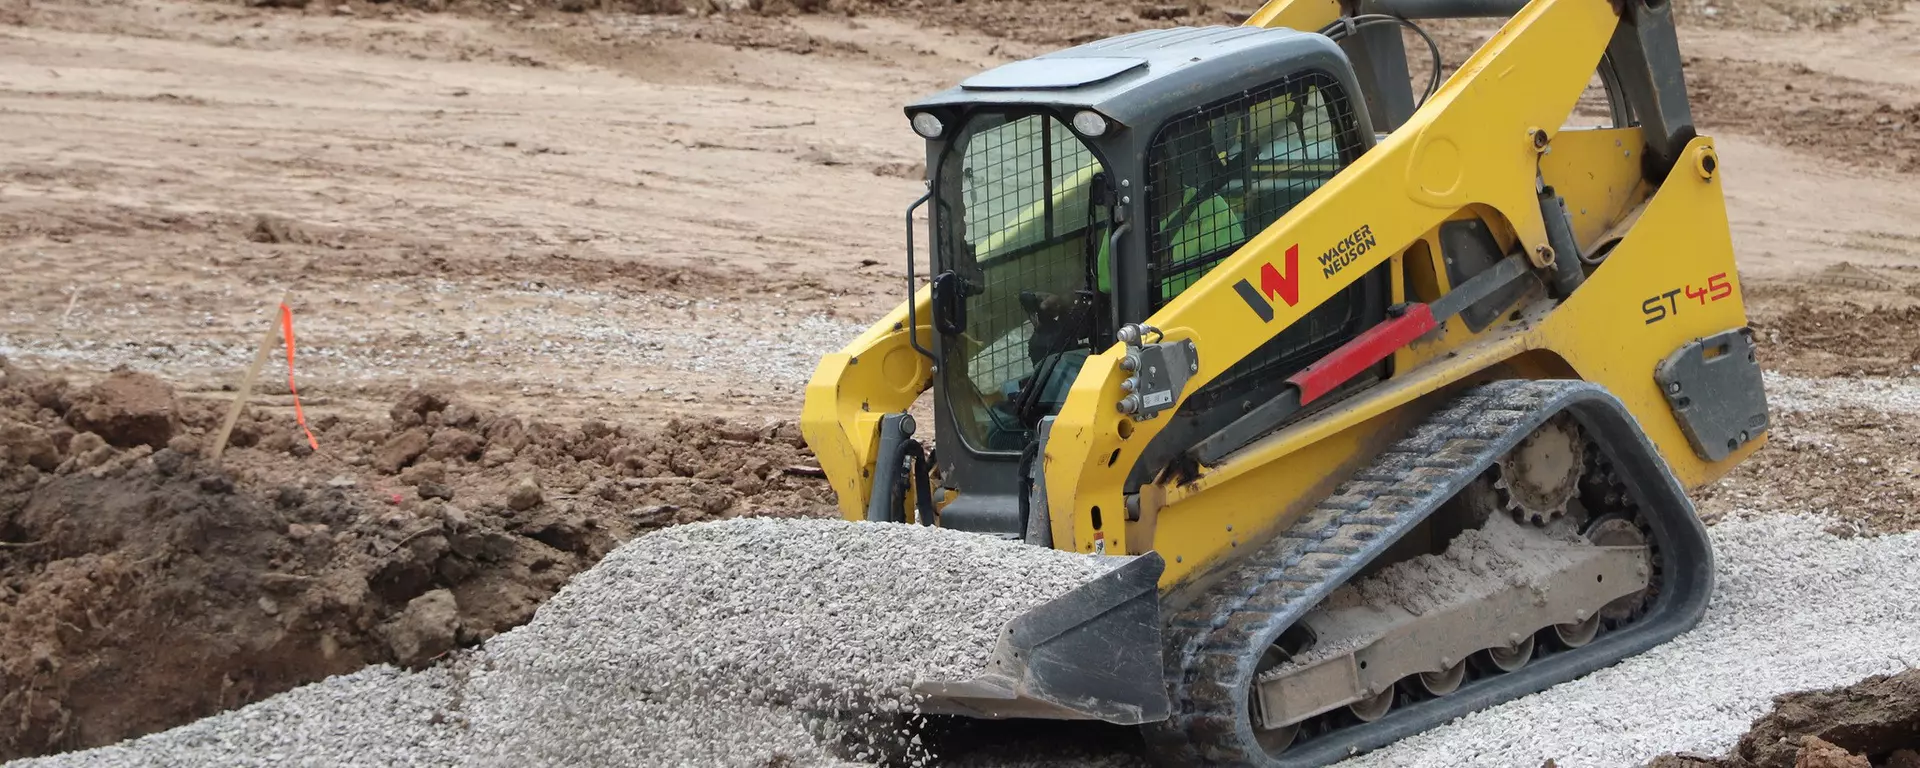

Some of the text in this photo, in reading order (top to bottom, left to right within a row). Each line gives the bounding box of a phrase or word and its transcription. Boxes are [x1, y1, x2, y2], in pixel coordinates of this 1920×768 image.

[1317, 224, 1372, 266] WACKER
[1323, 235, 1376, 280] NEUSON
[1642, 272, 1732, 325] ST45
